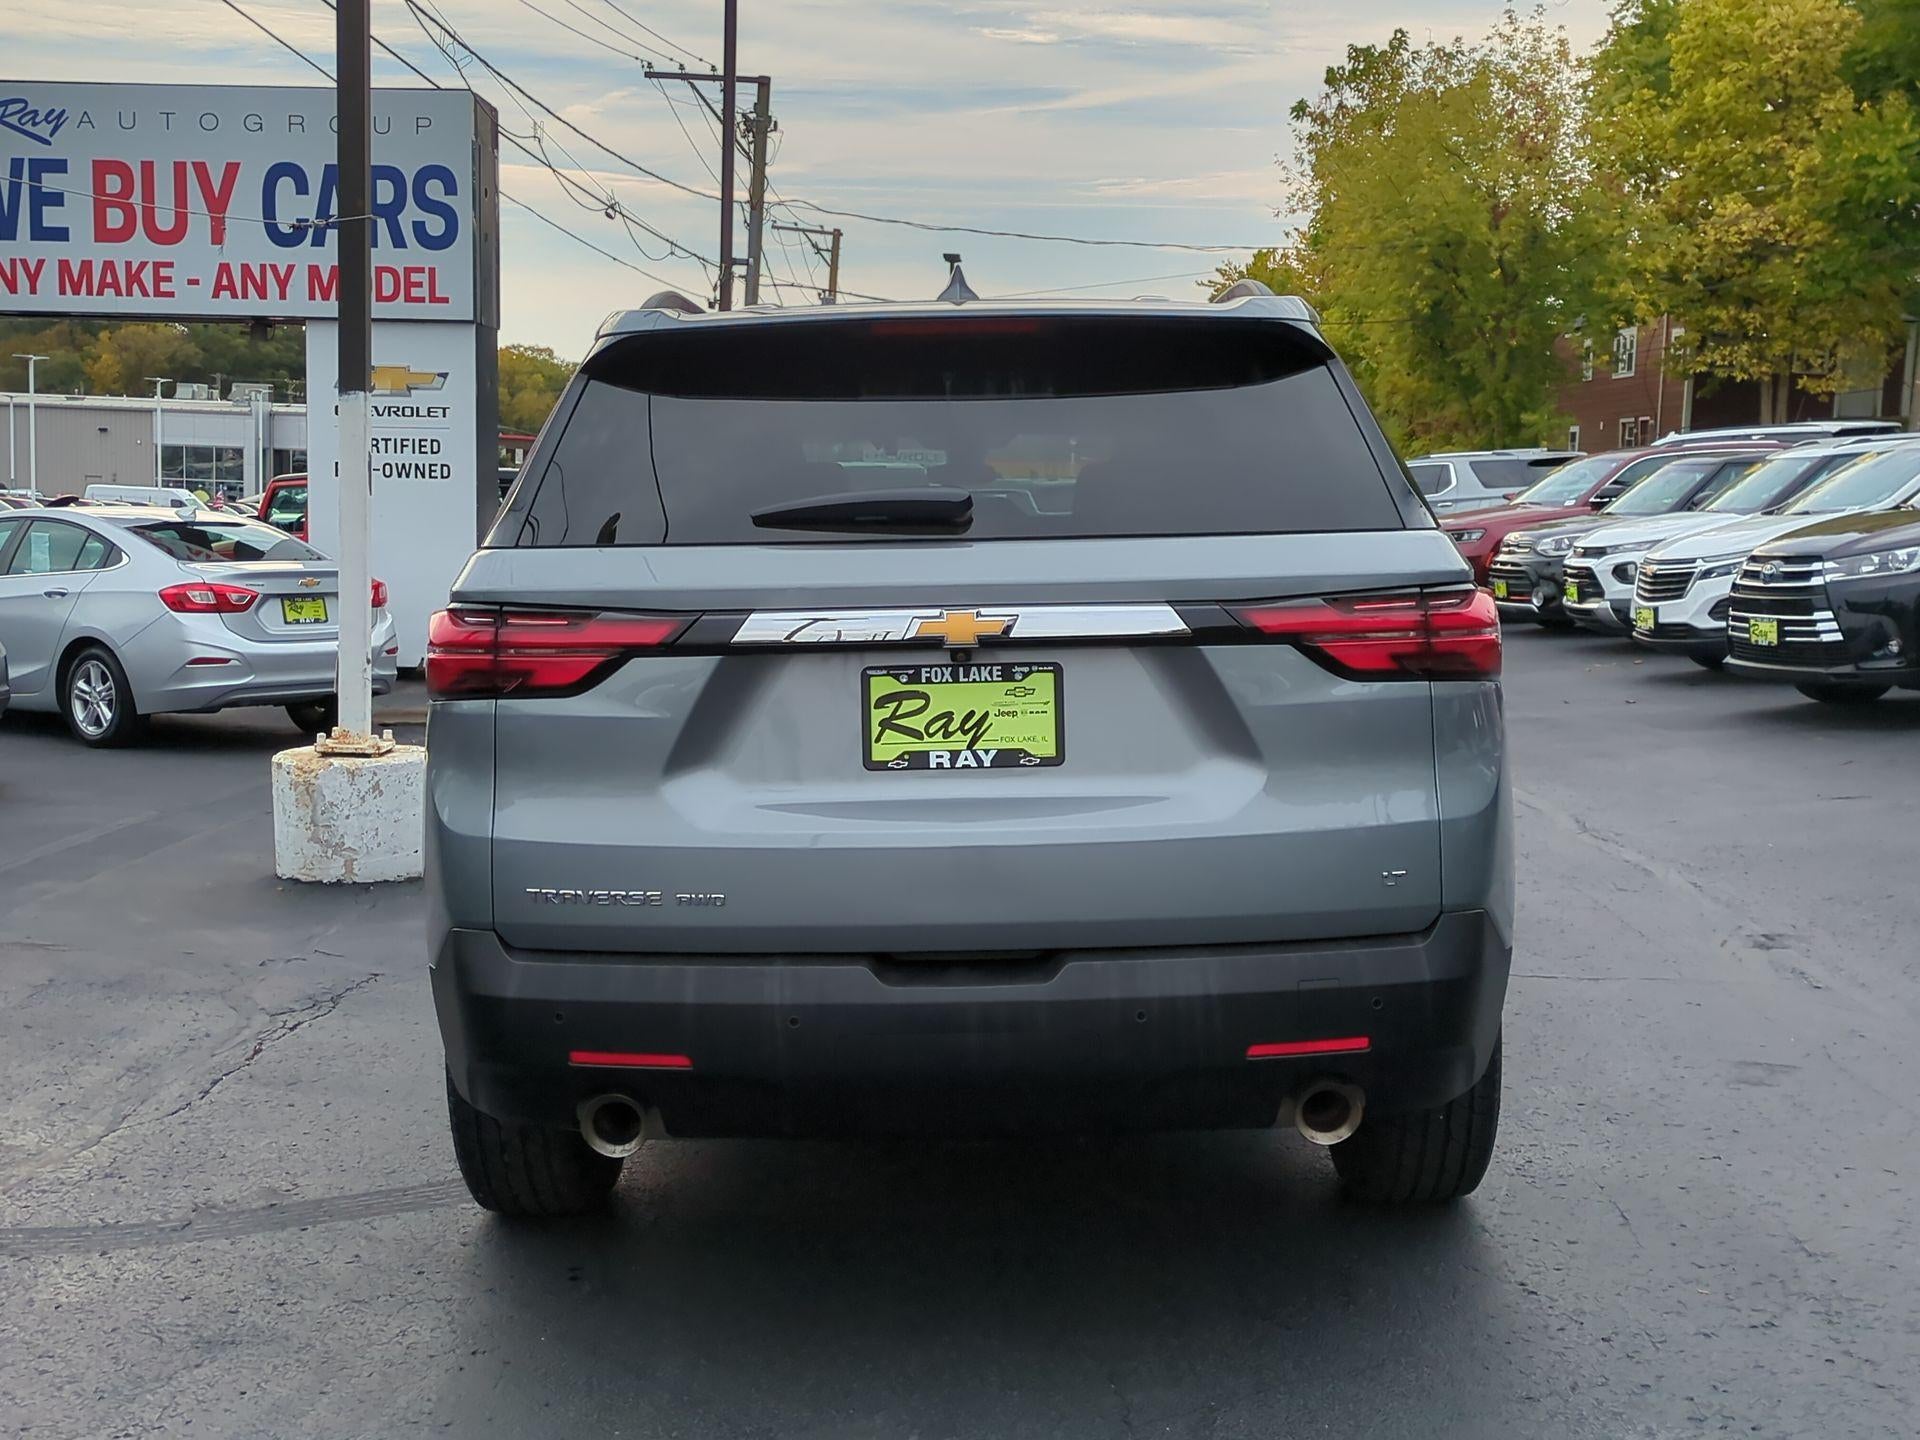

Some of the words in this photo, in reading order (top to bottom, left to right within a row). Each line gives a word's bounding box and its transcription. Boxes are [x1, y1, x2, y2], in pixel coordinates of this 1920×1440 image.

[0, 98, 69, 146] Ray
[92, 159, 241, 246] BUY
[262, 161, 459, 251] CARS
[0, 258, 46, 296] NY
[57, 258, 175, 298] MAKE
[211, 262, 296, 300] ANY
[307, 264, 450, 304] MDEL
[335, 405, 451, 419] VROLET
[370, 437, 442, 455] RTIFIED
[921, 666, 953, 683] FOX
[958, 665, 1003, 682] LAKE
[1011, 665, 1030, 673] Jeep
[873, 689, 994, 750] Ray
[994, 709, 1018, 718] Jeep
[1000, 735, 1016, 743] FOX
[928, 749, 998, 769] RAY
[526, 888, 663, 906] TRAVERSE
[676, 893, 726, 907] AWD
